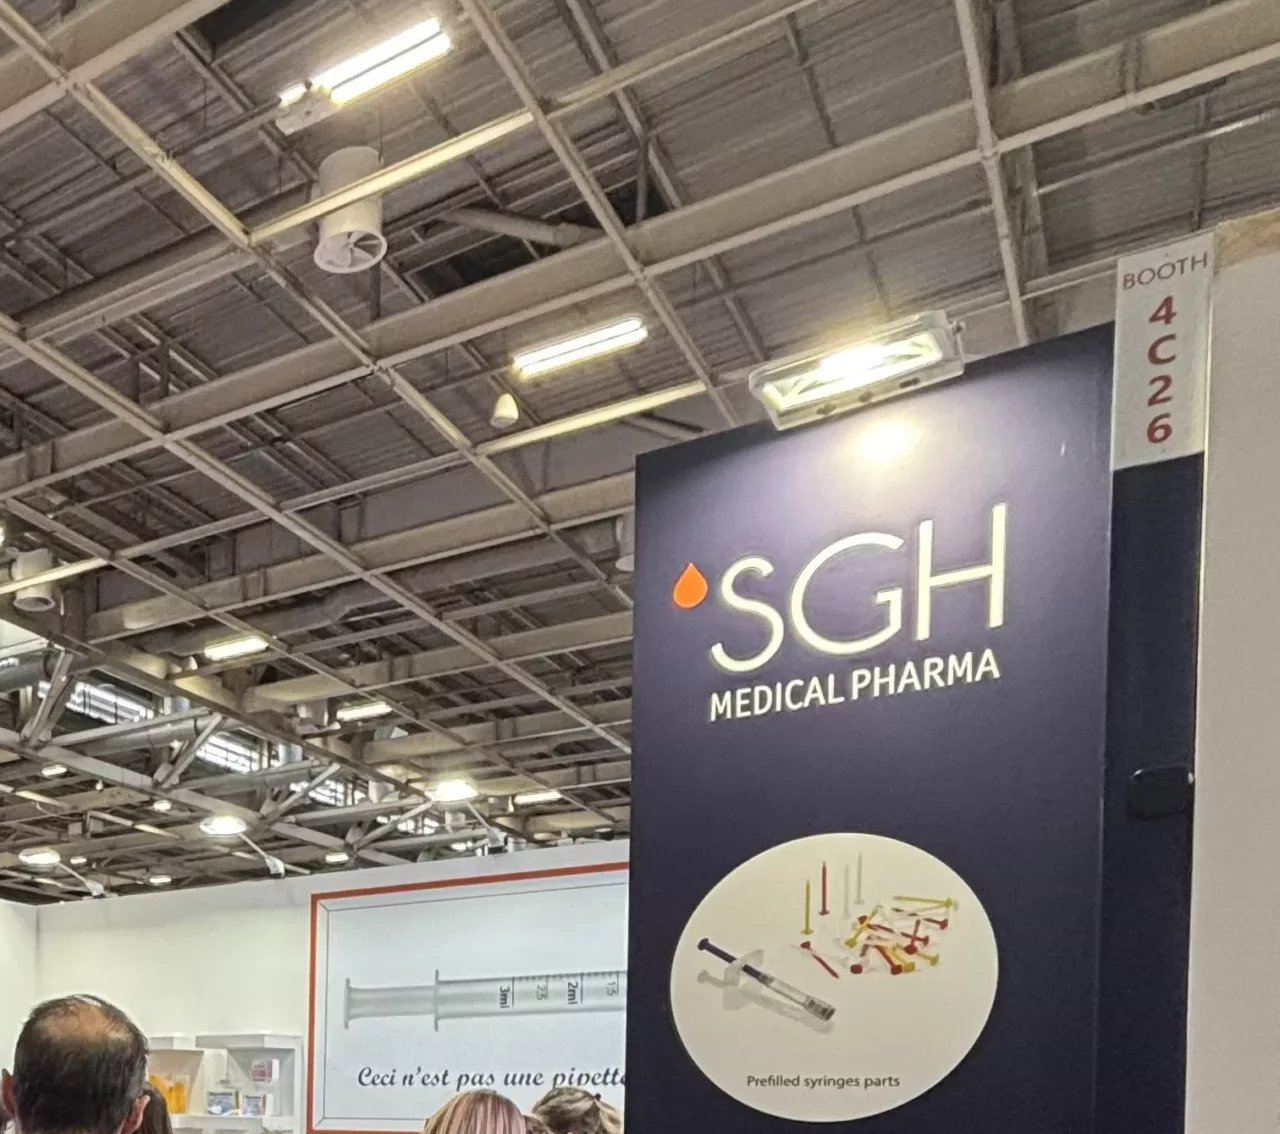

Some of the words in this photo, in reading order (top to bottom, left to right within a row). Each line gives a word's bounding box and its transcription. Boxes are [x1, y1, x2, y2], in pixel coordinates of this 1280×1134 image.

[1122, 251, 1208, 290] BOOTH
[710, 502, 1007, 673] SGH
[709, 674, 845, 722] MEDICAL
[851, 648, 1000, 701] PHARMA
[357, 1066, 396, 1087] Ceci
[402, 1066, 449, 1087] n'est
[456, 1073, 495, 1092] pas
[504, 1072, 545, 1087] une
[747, 1075, 800, 1088] Prefilled
[804, 1075, 860, 1090] syringes
[864, 1076, 900, 1091] parts
